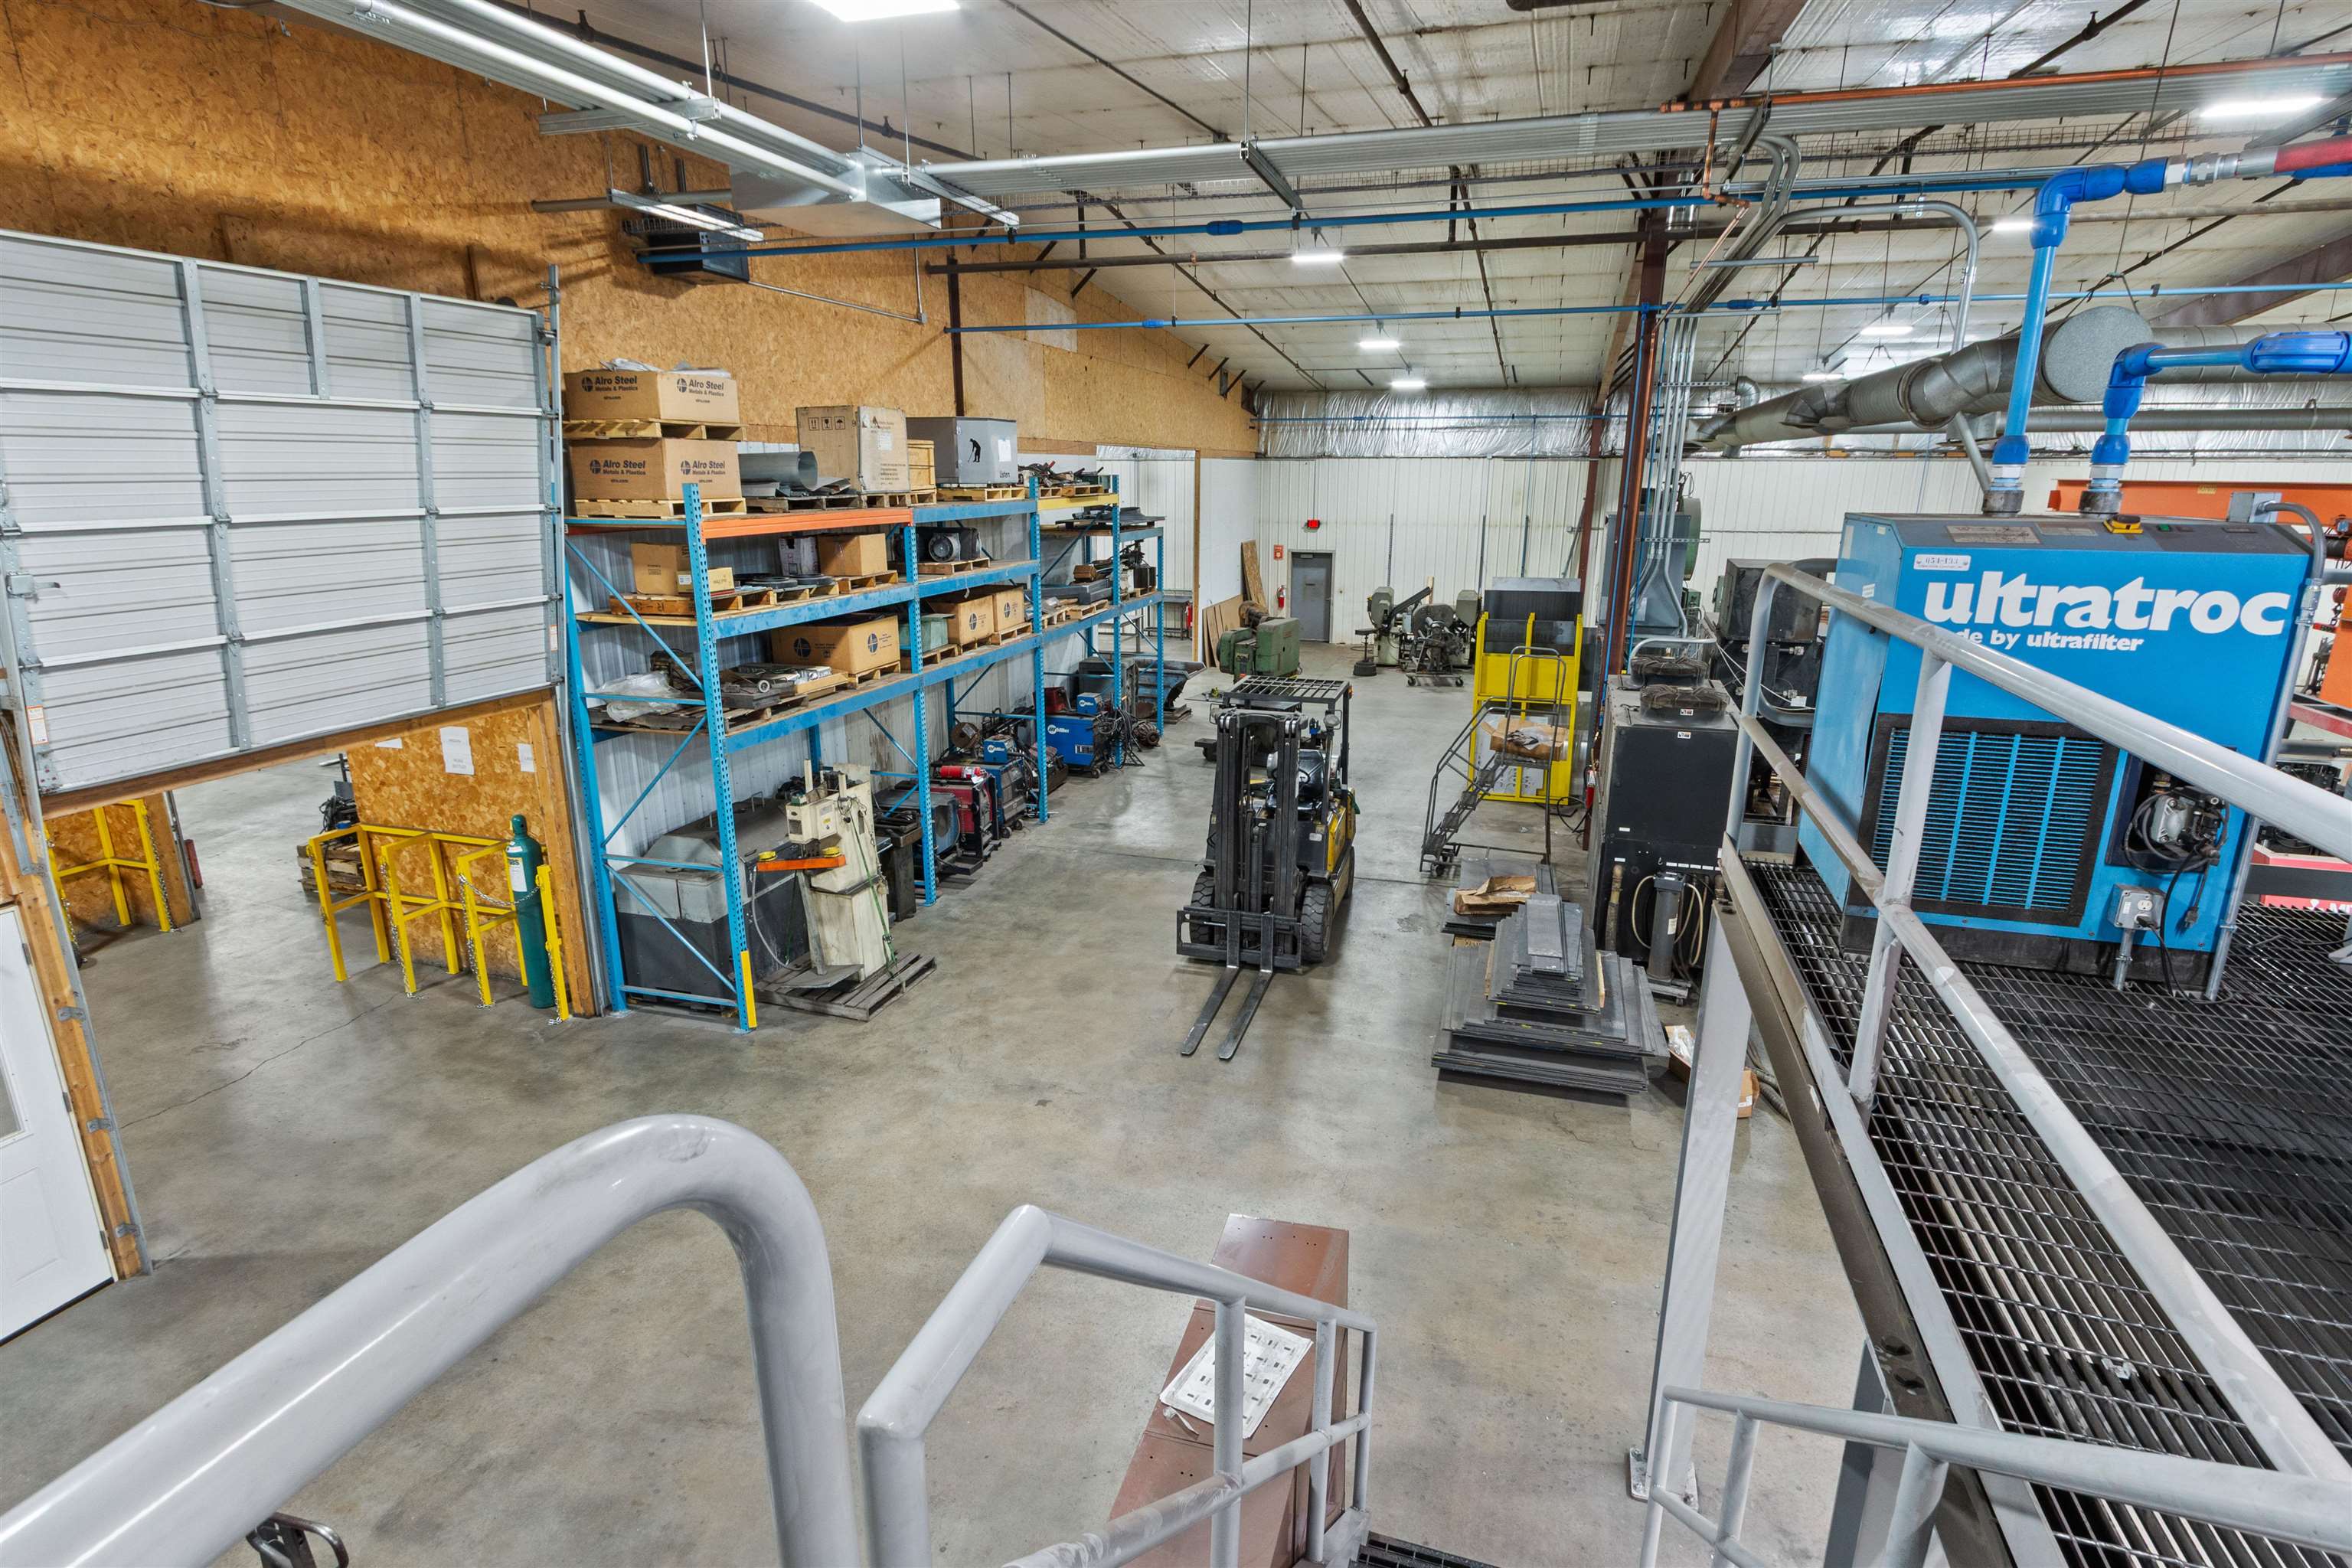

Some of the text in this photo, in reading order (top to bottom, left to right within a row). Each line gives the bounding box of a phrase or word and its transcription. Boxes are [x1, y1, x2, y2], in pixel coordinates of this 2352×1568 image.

[595, 375, 637, 385] Alro Steel
[689, 379, 724, 390] Alro Steel
[603, 459, 645, 469] Alro Steel
[693, 460, 725, 469] Alro Steel
[1922, 570, 2292, 636] ultratroc
[1990, 629, 2020, 650] by
[2026, 630, 2145, 652] ultrafilter
